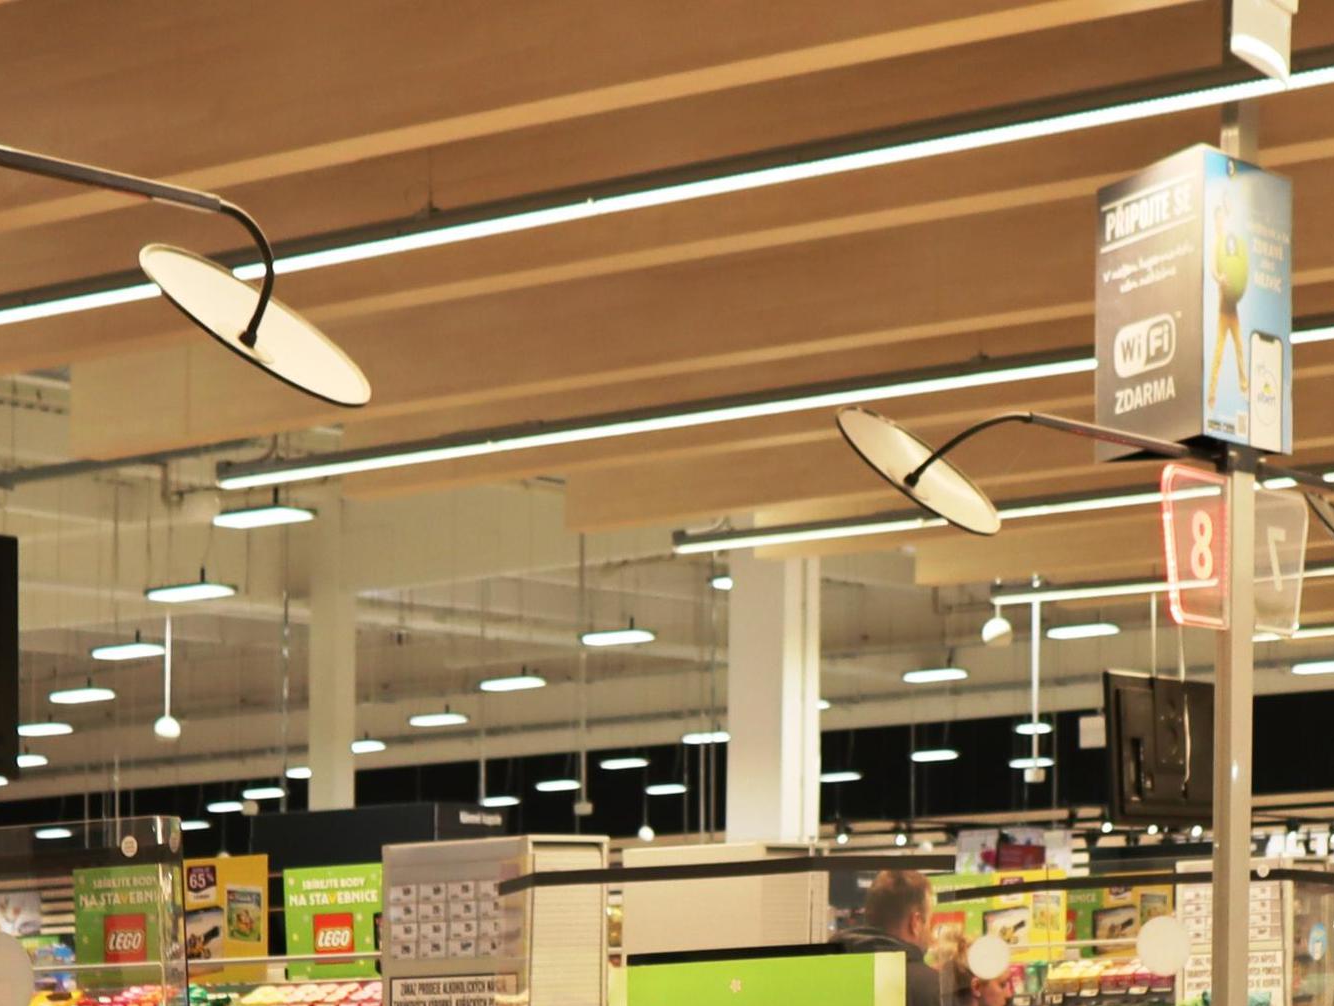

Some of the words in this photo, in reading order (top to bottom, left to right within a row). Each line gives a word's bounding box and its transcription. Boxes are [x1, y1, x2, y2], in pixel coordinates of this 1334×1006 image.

[1114, 376, 1176, 415] ZDARMA
[340, 876, 365, 889] BODY
[79, 892, 97, 908] NA
[289, 892, 307, 907] NA
[310, 889, 378, 906] STAVEBNICE
[108, 929, 143, 951] LEGO
[317, 927, 351, 950] LEGO
